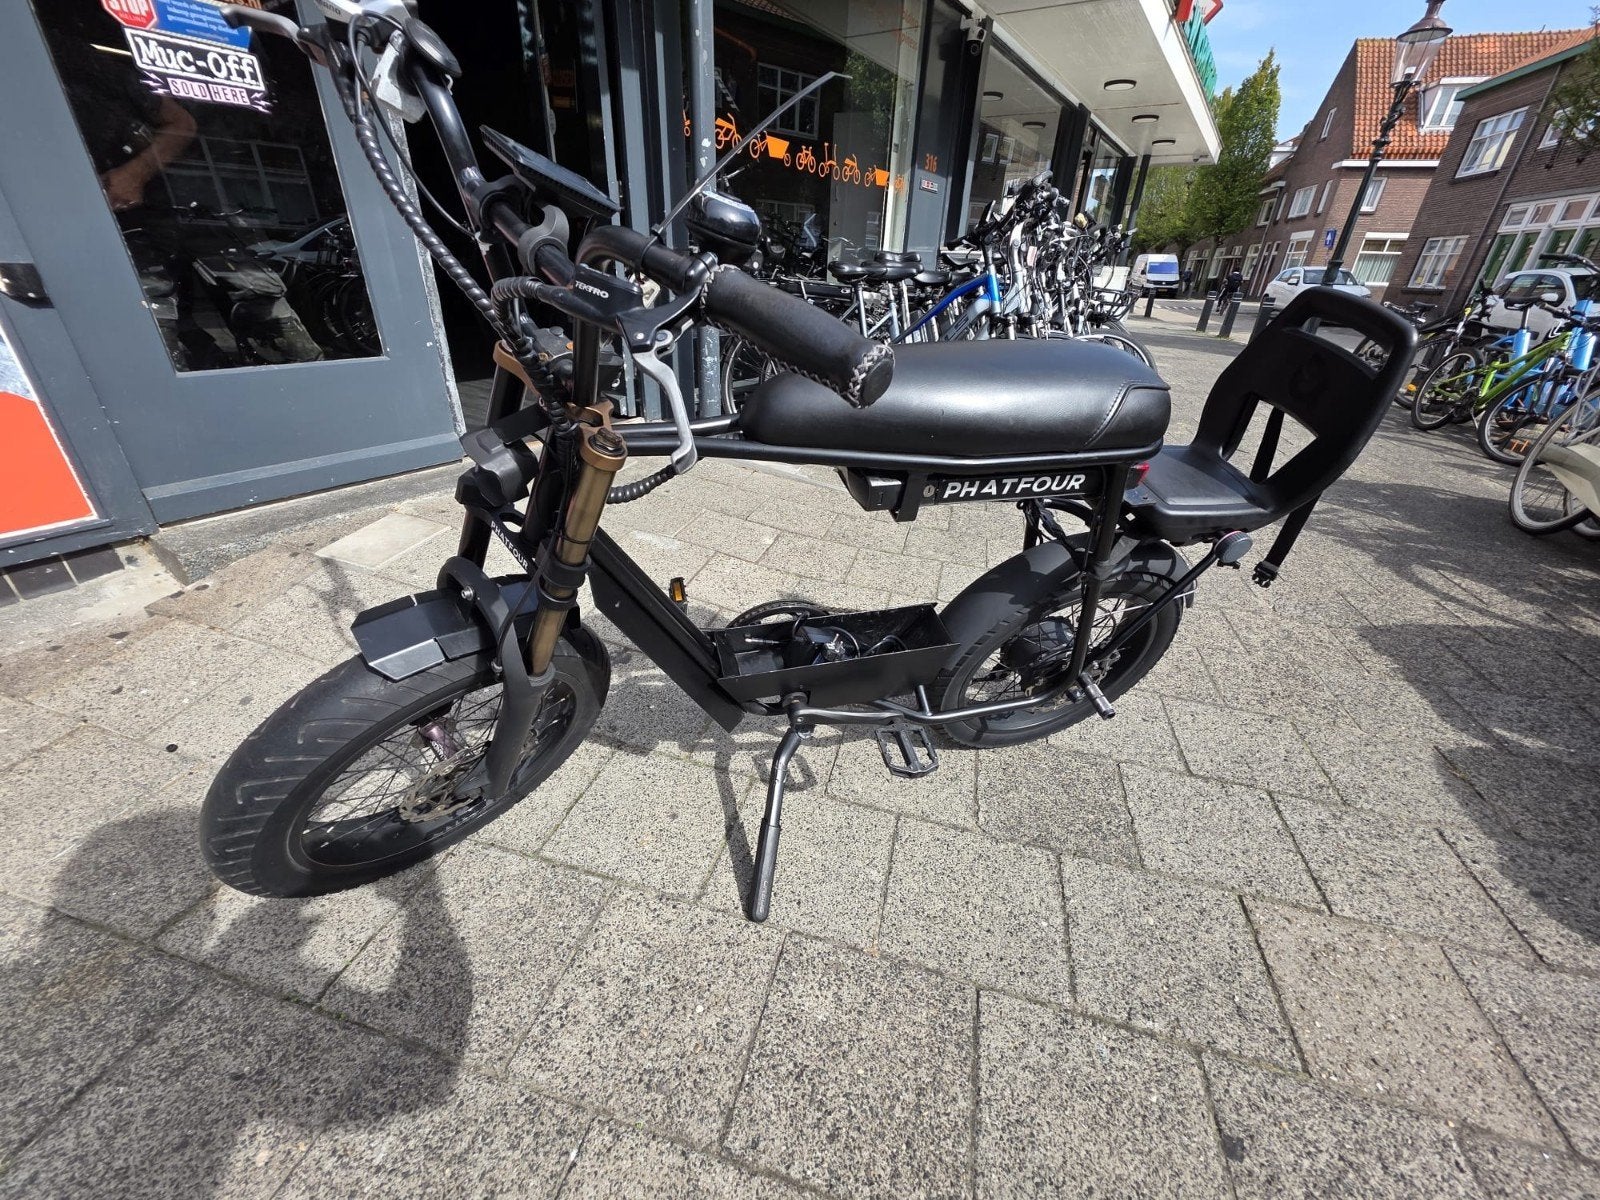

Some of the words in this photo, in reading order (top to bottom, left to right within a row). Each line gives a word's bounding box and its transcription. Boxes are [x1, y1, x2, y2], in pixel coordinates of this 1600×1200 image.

[135, 36, 256, 85] Muc-Off
[171, 79, 208, 99] SOLD
[212, 84, 248, 105] HERE
[924, 152, 938, 173] 316
[575, 280, 610, 299] TEKTRO
[943, 473, 1086, 499] PHATFOUR
[490, 520, 529, 570] PHATFOUR
